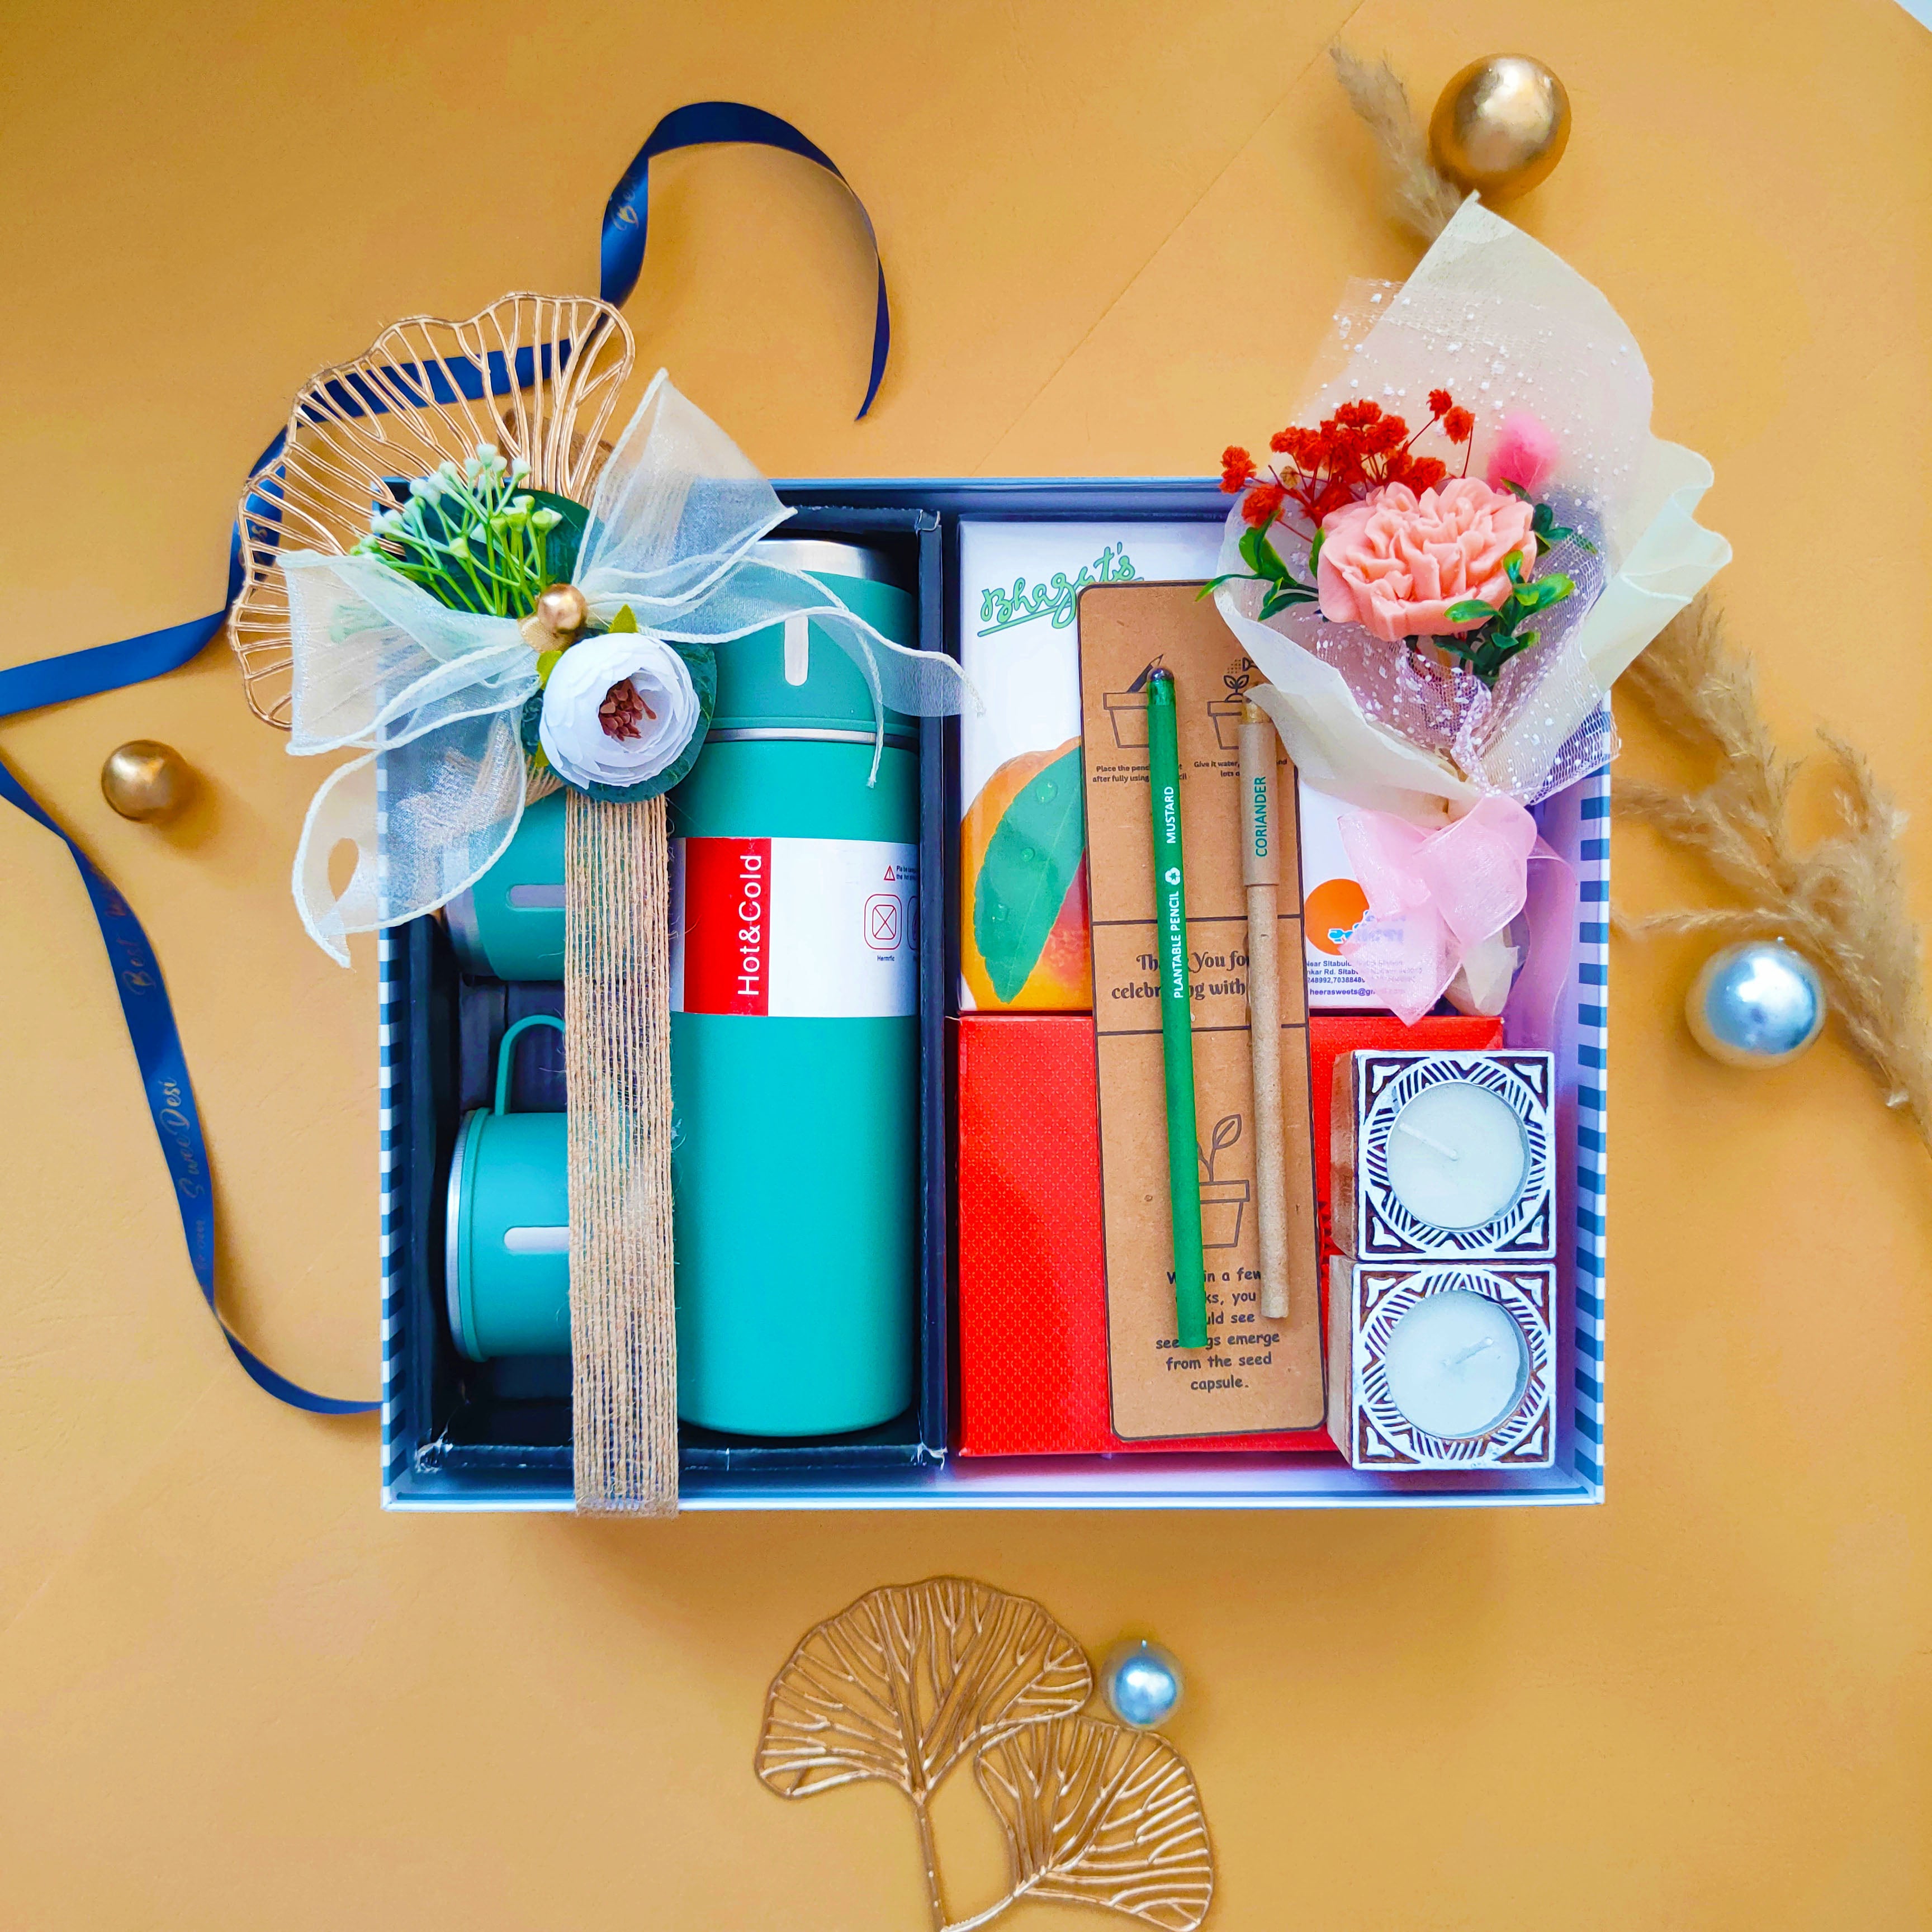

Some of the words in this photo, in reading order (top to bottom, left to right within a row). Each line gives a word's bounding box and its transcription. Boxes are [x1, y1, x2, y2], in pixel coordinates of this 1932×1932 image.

[1112, 775, 1129, 783] fully
[1130, 774, 1150, 783] using
[1164, 786, 1176, 844] MUSTARD
[1254, 776, 1267, 857] CORIANDER
[1169, 891, 1180, 931] PENCIL
[737, 855, 762, 996] Hot&Cold
[1171, 934, 1183, 998] PLANTABLE
[1188, 951, 1225, 973] You
[1111, 982, 1205, 1000] celebrg
[1209, 978, 1246, 995] with
[1222, 1272, 1230, 1281] a
[1232, 1292, 1256, 1306] you
[1230, 1313, 1256, 1324] see
[1156, 1336, 1221, 1351] seegs
[1227, 1333, 1280, 1347] emerge
[1166, 1357, 1201, 1371] from
[1207, 1355, 1232, 1368] the
[1238, 1351, 1272, 1367] seed
[1190, 1375, 1249, 1393] capsule.
